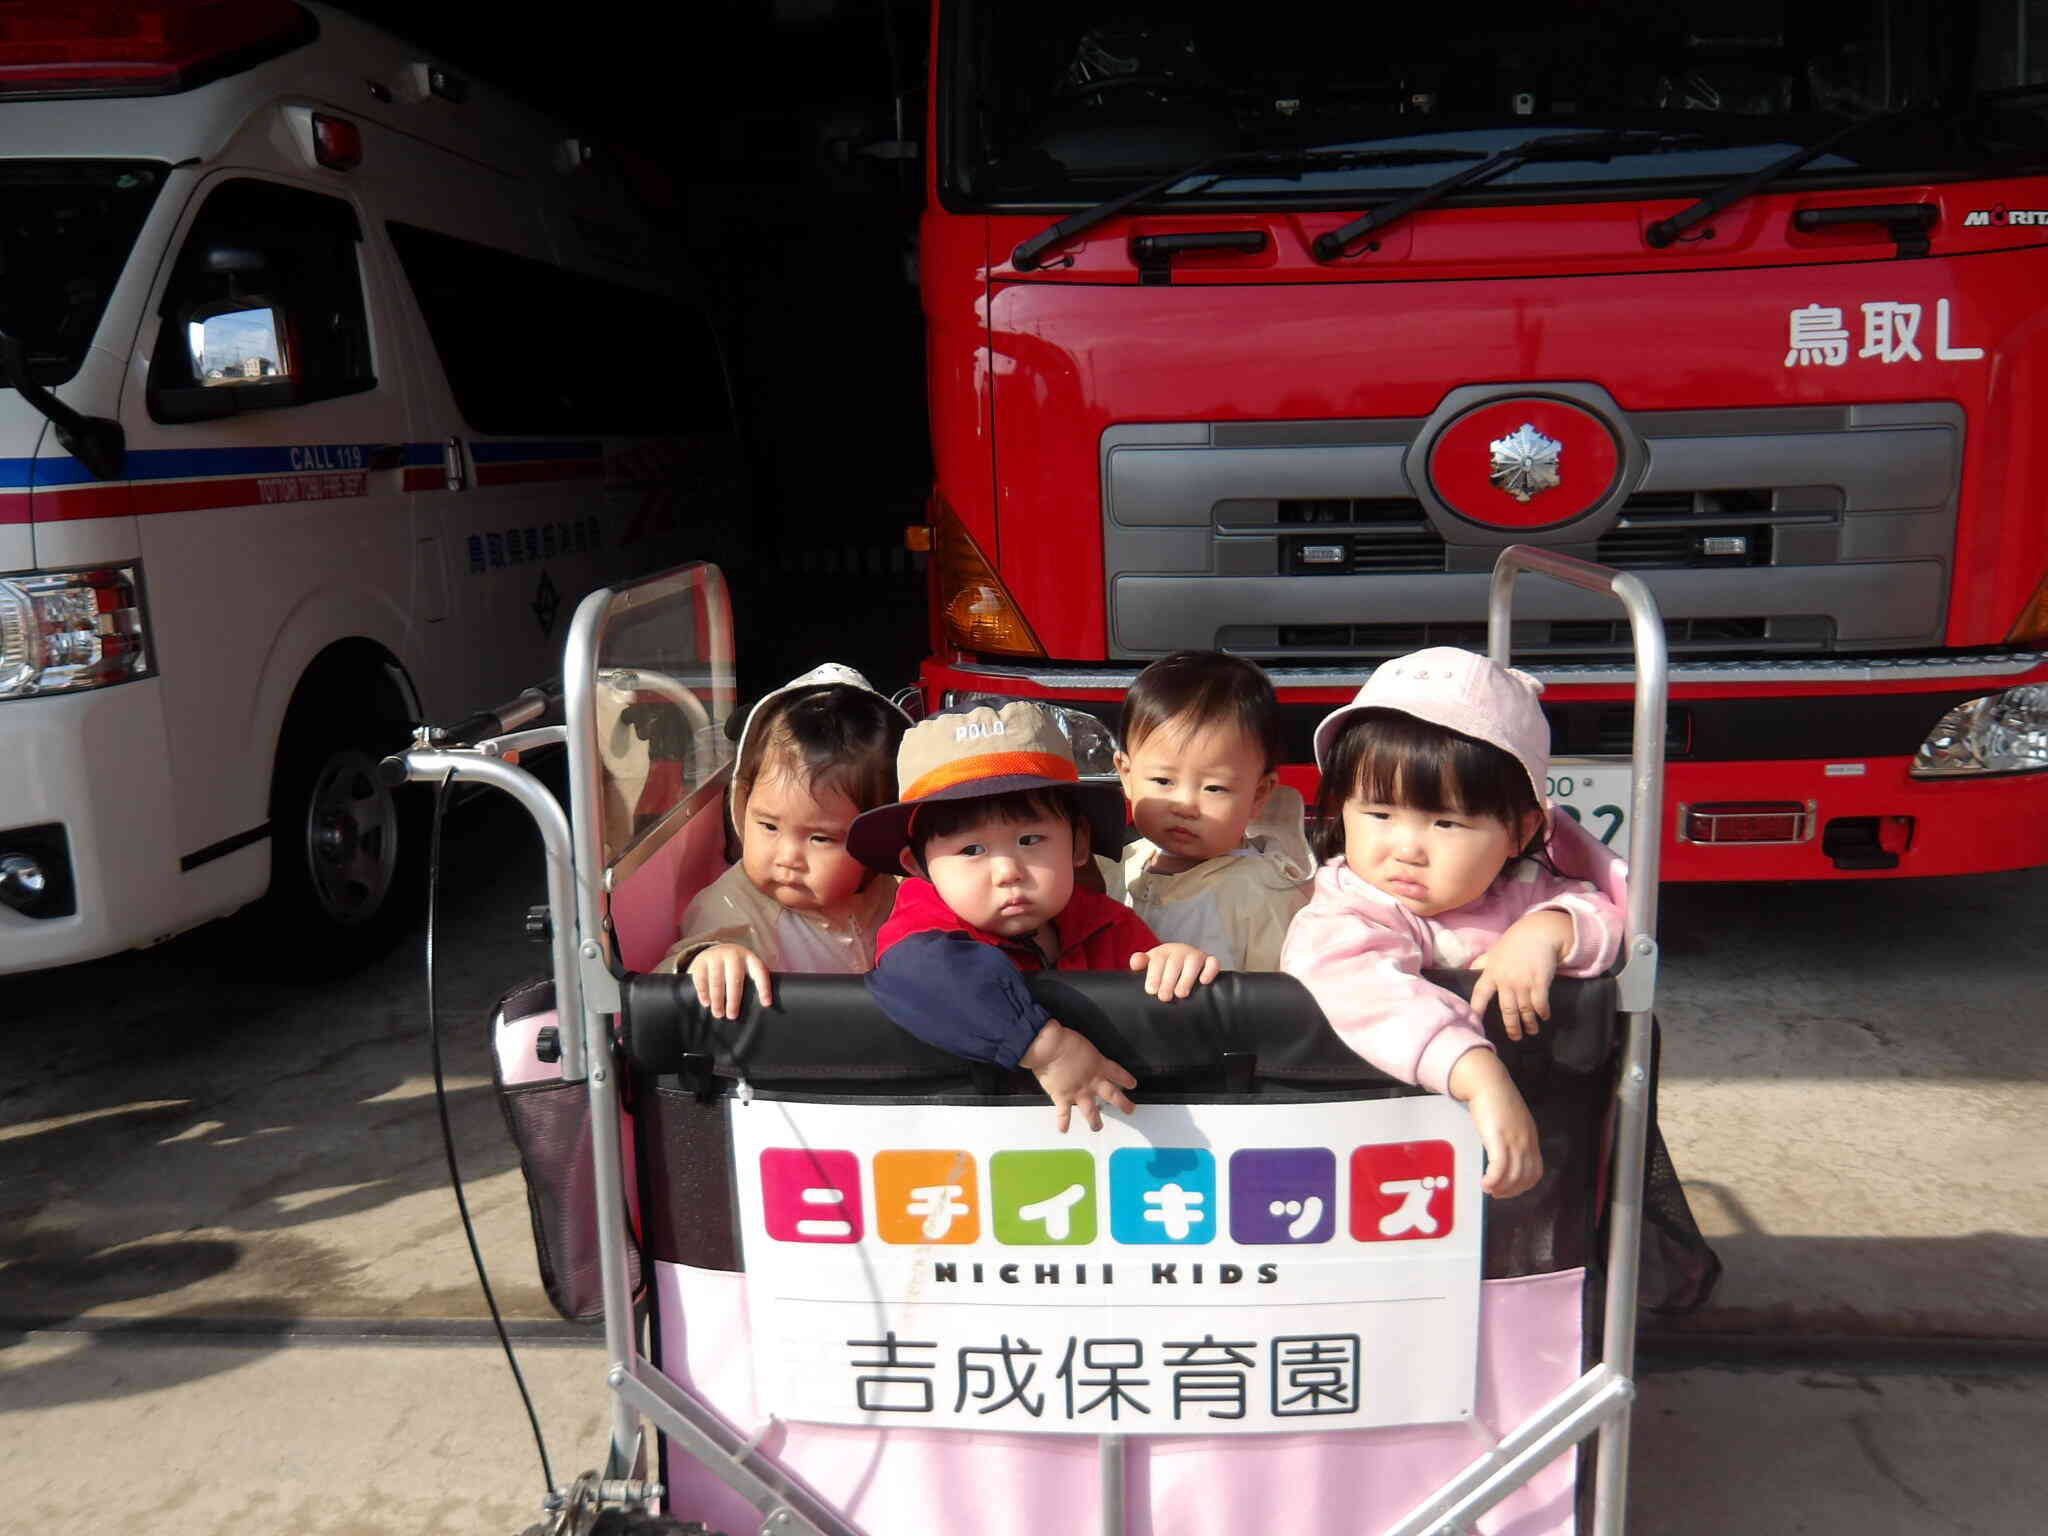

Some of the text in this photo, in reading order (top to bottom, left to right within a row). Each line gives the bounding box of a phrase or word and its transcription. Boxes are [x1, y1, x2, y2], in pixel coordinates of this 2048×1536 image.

[1963, 207, 2048, 226] MORIT
[290, 446, 361, 470] CALL 119
[955, 720, 1006, 743] POLO
[792, 1172, 1452, 1241] ニチイキッズ
[935, 1262, 1280, 1285] NICHII KIDS
[846, 1331, 1361, 1421] 吉成保育園
